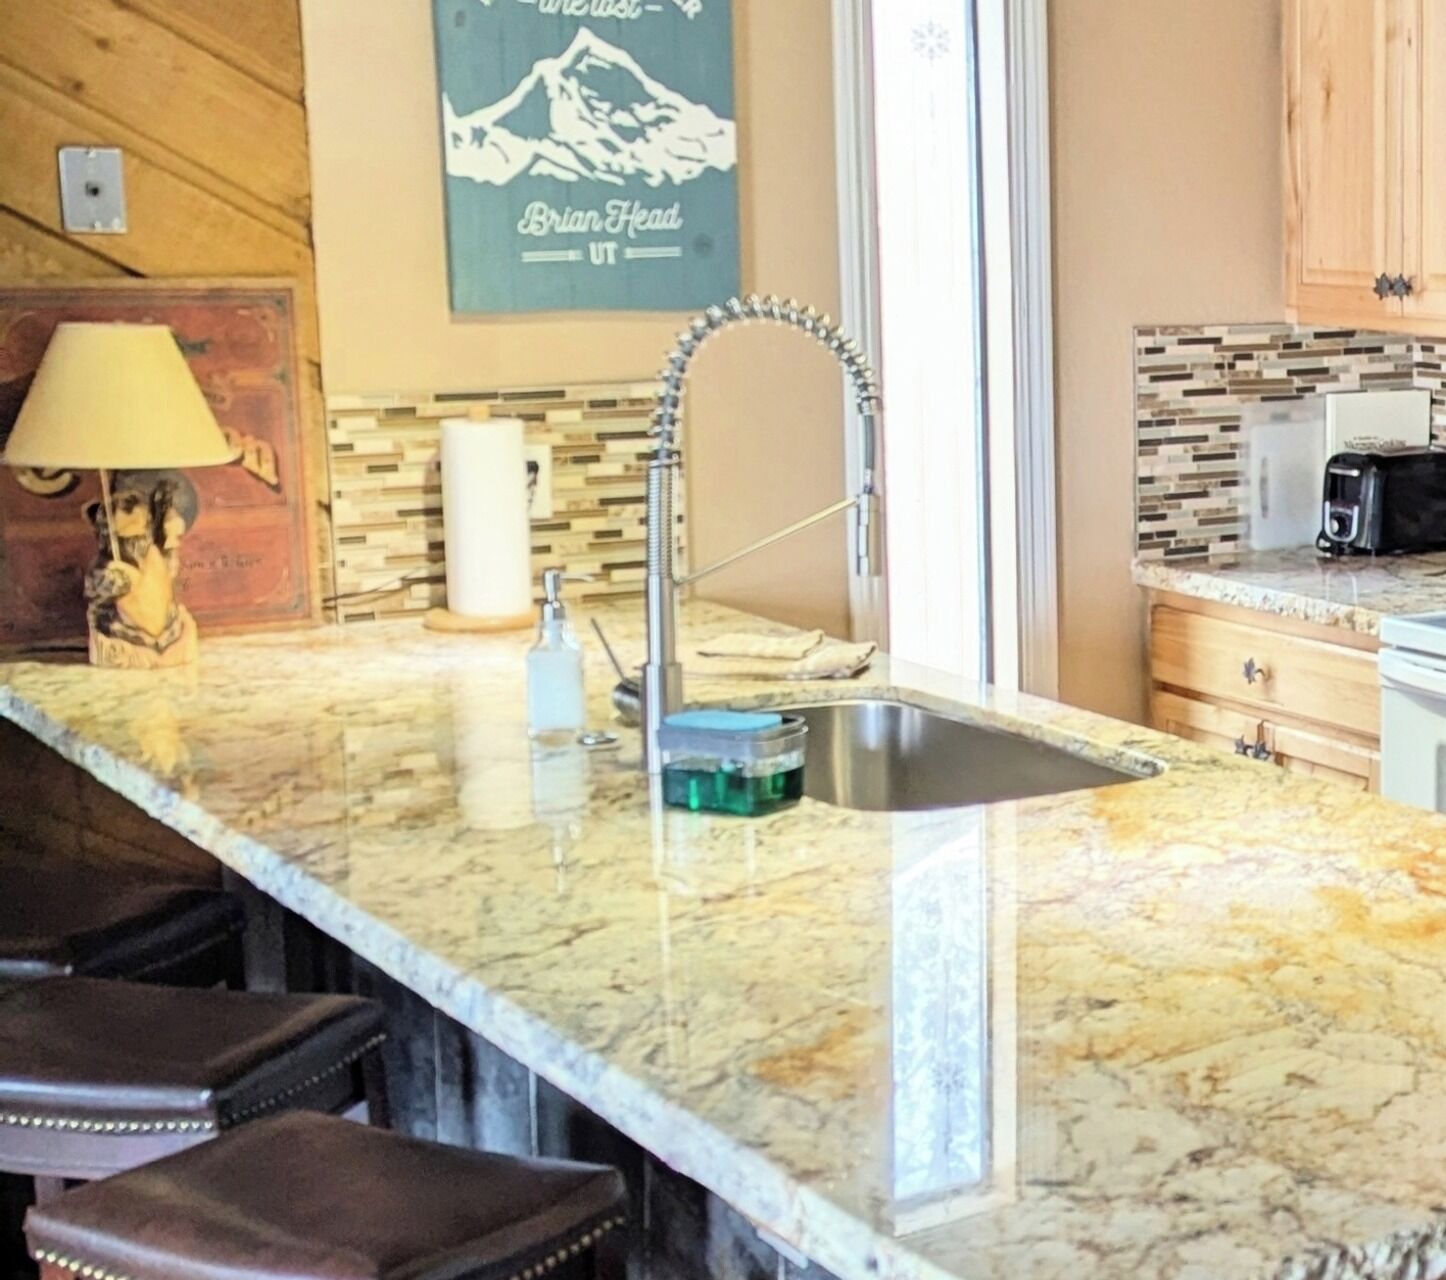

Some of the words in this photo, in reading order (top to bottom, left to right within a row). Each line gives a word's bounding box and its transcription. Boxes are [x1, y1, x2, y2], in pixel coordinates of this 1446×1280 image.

[517, 201, 603, 237] Brian
[604, 198, 684, 239] Head
[588, 241, 618, 265] UT
